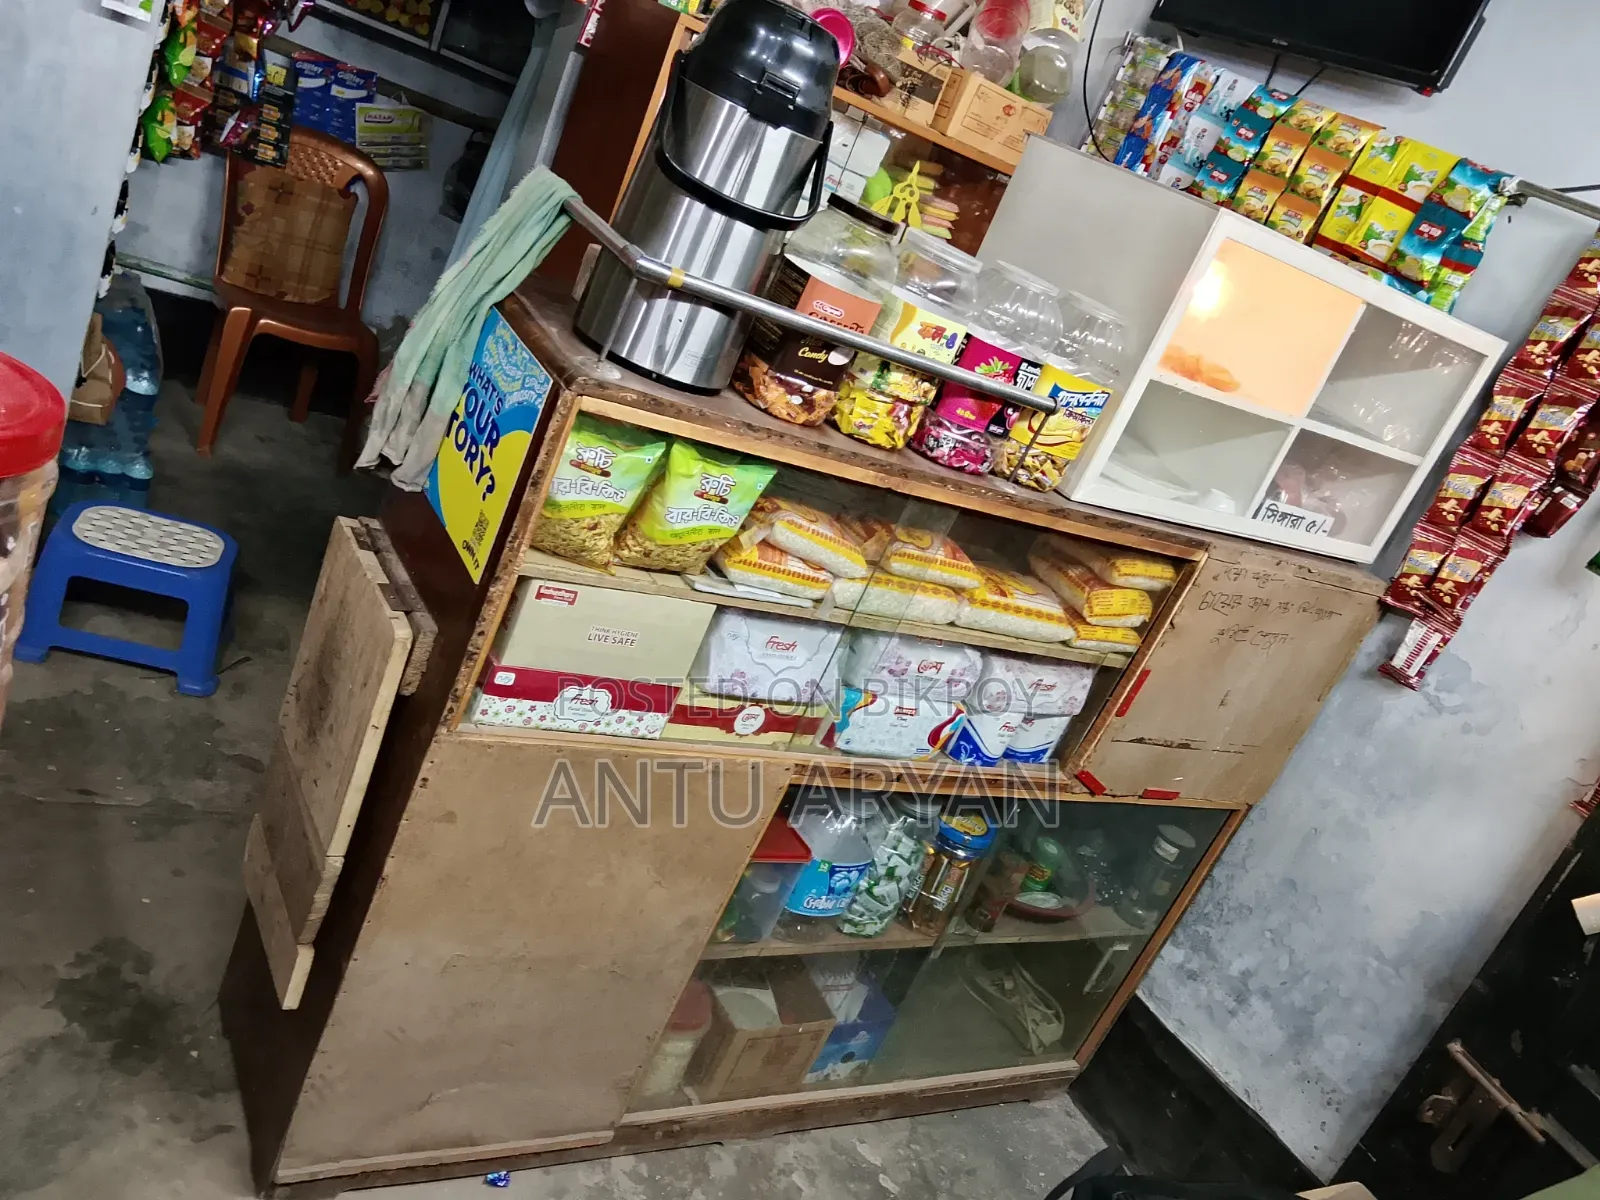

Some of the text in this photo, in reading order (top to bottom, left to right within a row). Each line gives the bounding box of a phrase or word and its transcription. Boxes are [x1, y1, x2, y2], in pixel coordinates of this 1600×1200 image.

[798, 346, 829, 364] Candy
[470, 362, 503, 416] WHAT'S
[446, 409, 497, 502] TORY?
[577, 442, 617, 469] রুচি
[550, 475, 627, 503] ার-বি-কিউ
[700, 473, 737, 497] রুচি
[1445, 479, 1472, 498] RUSK
[665, 504, 741, 529] বার-বি-কিউ
[1261, 502, 1306, 530] সিঙ্গারা
[461, 539, 476, 562] OWN
[587, 632, 637, 647] LIVE SAFE
[590, 626, 640, 638] THINK HYGIENE
[765, 635, 798, 652] Fresh
[999, 720, 1017, 733] Fres
